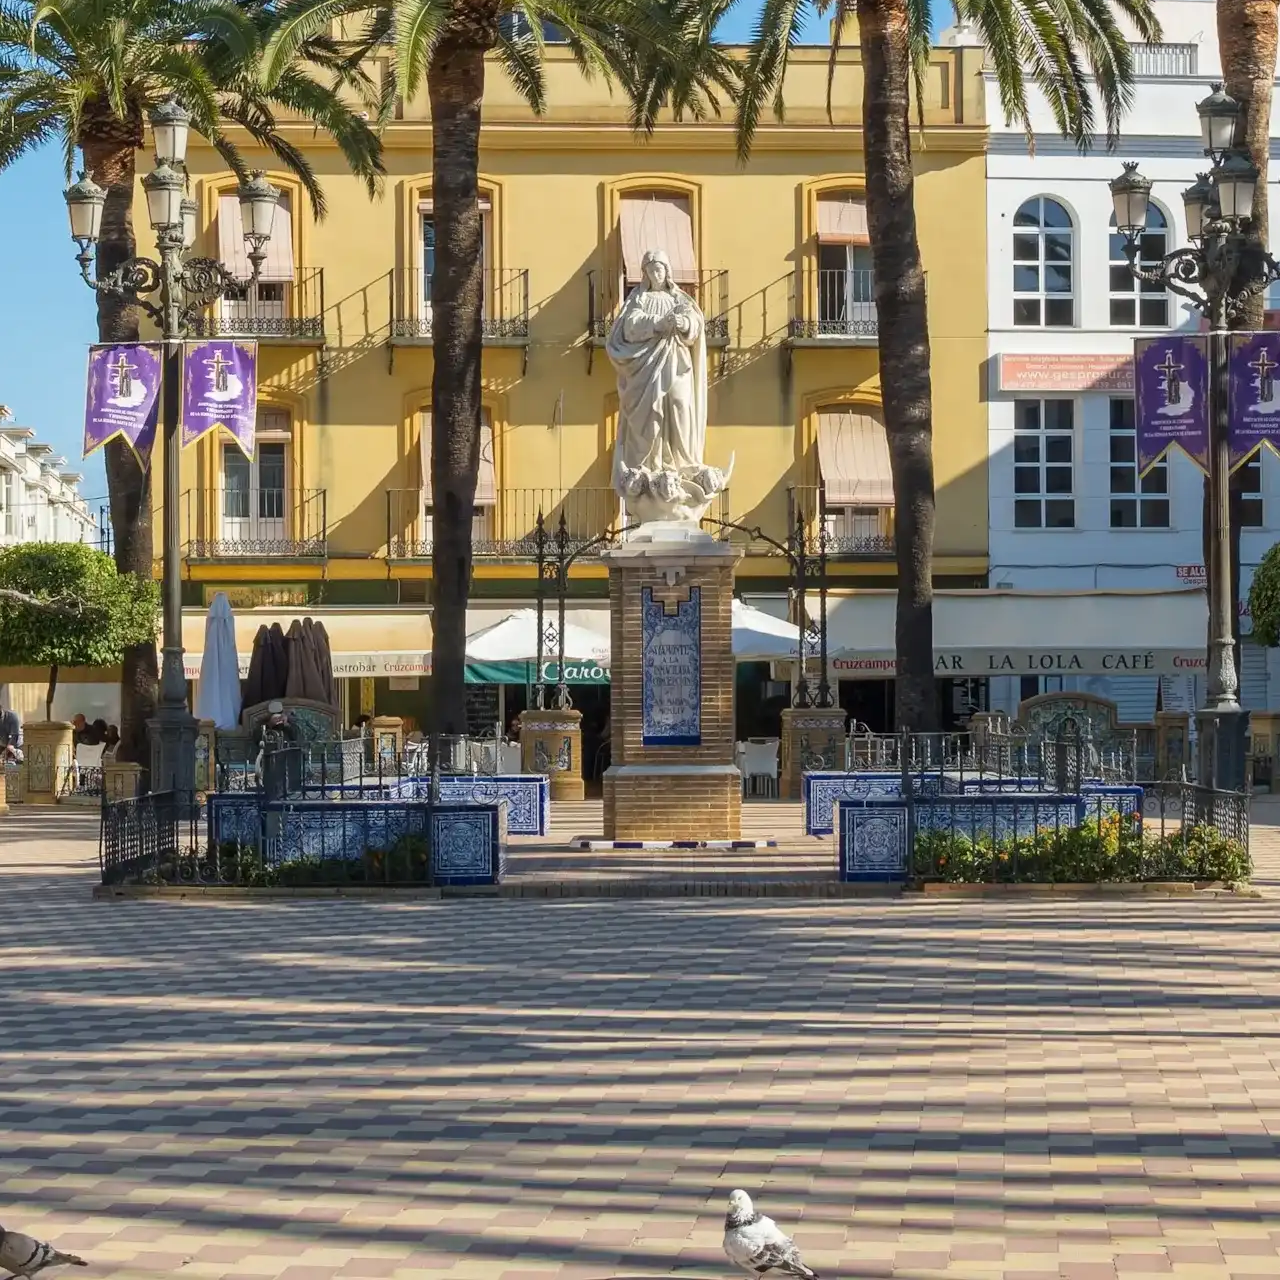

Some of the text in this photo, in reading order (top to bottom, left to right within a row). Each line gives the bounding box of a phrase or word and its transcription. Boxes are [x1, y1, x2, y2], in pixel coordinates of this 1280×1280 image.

[1177, 567, 1188, 577] SE
[988, 655, 1015, 670] LA
[1028, 654, 1084, 670] LOLA
[1102, 651, 1155, 670] CAFÉ
[384, 661, 433, 673] Cruzcamp
